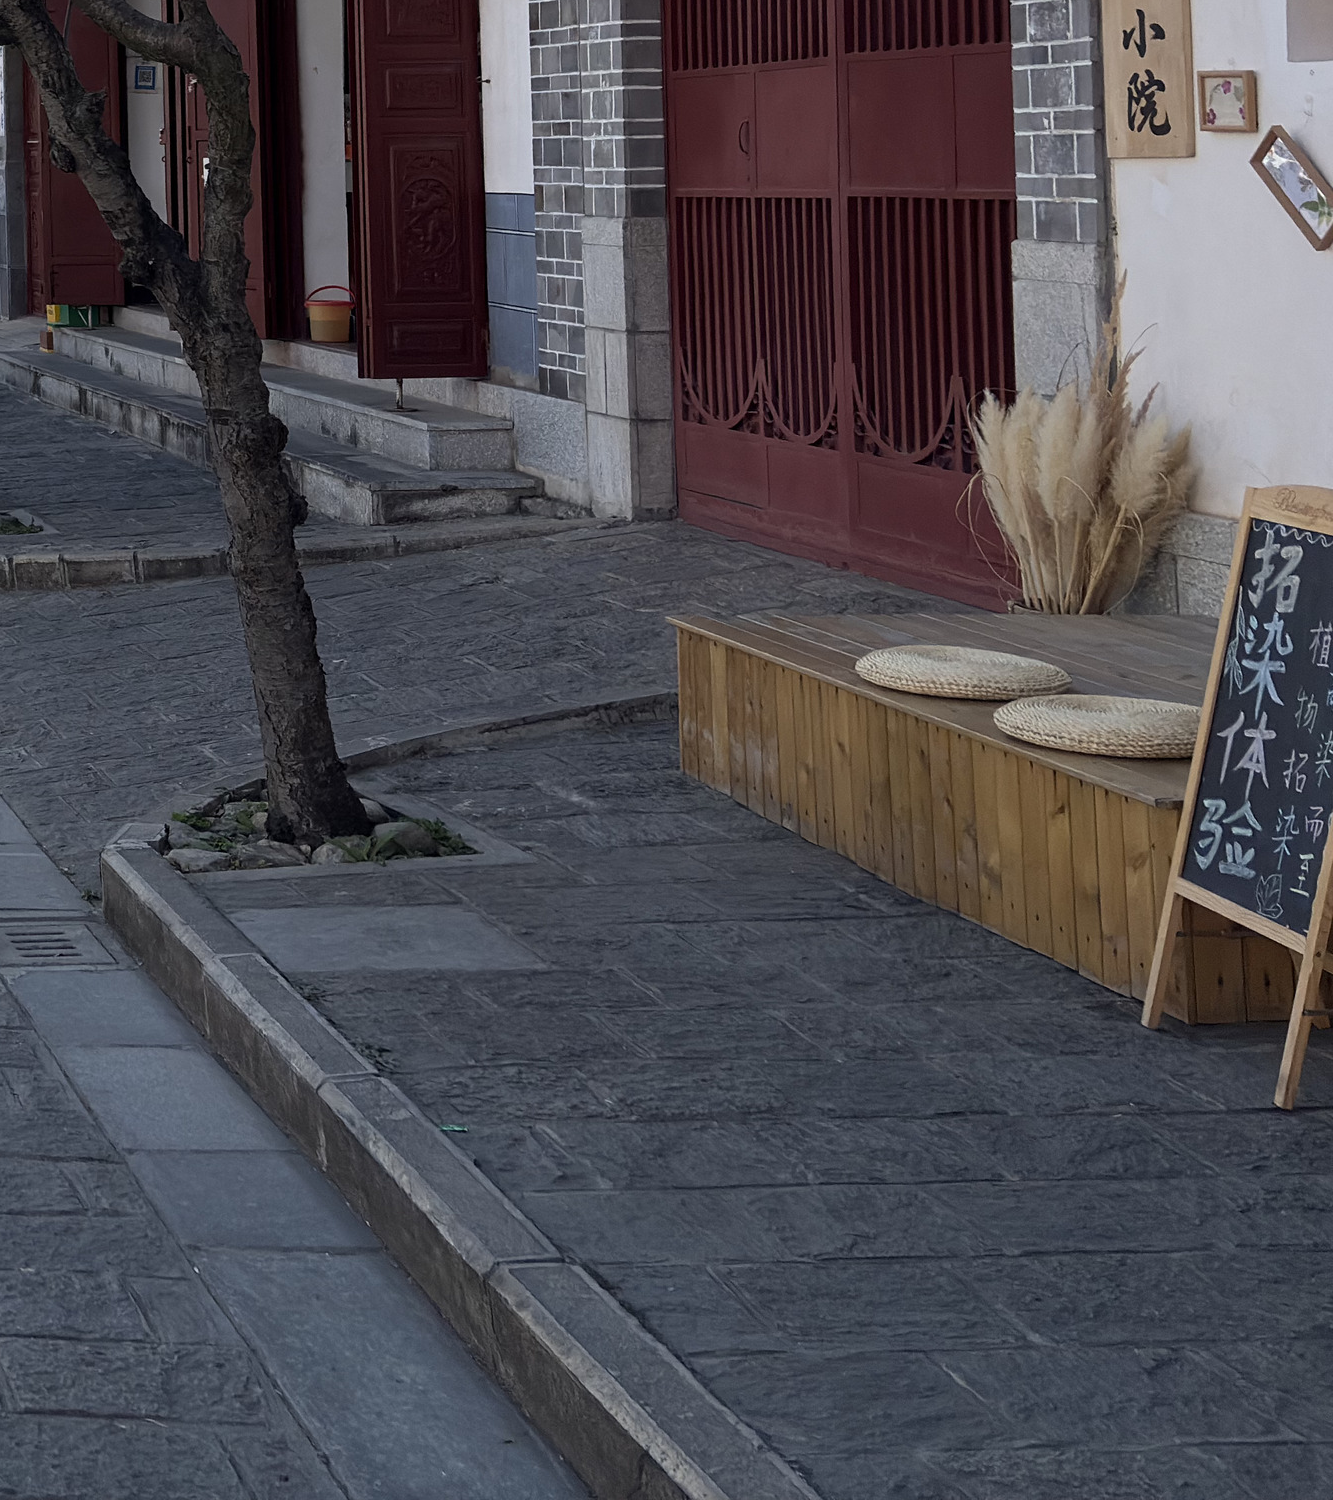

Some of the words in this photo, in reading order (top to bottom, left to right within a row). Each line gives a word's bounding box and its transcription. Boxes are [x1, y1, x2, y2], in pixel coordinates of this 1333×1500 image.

[1194, 530, 1304, 880] 拓染体验
[1271, 620, 1333, 871] 植物拓染
